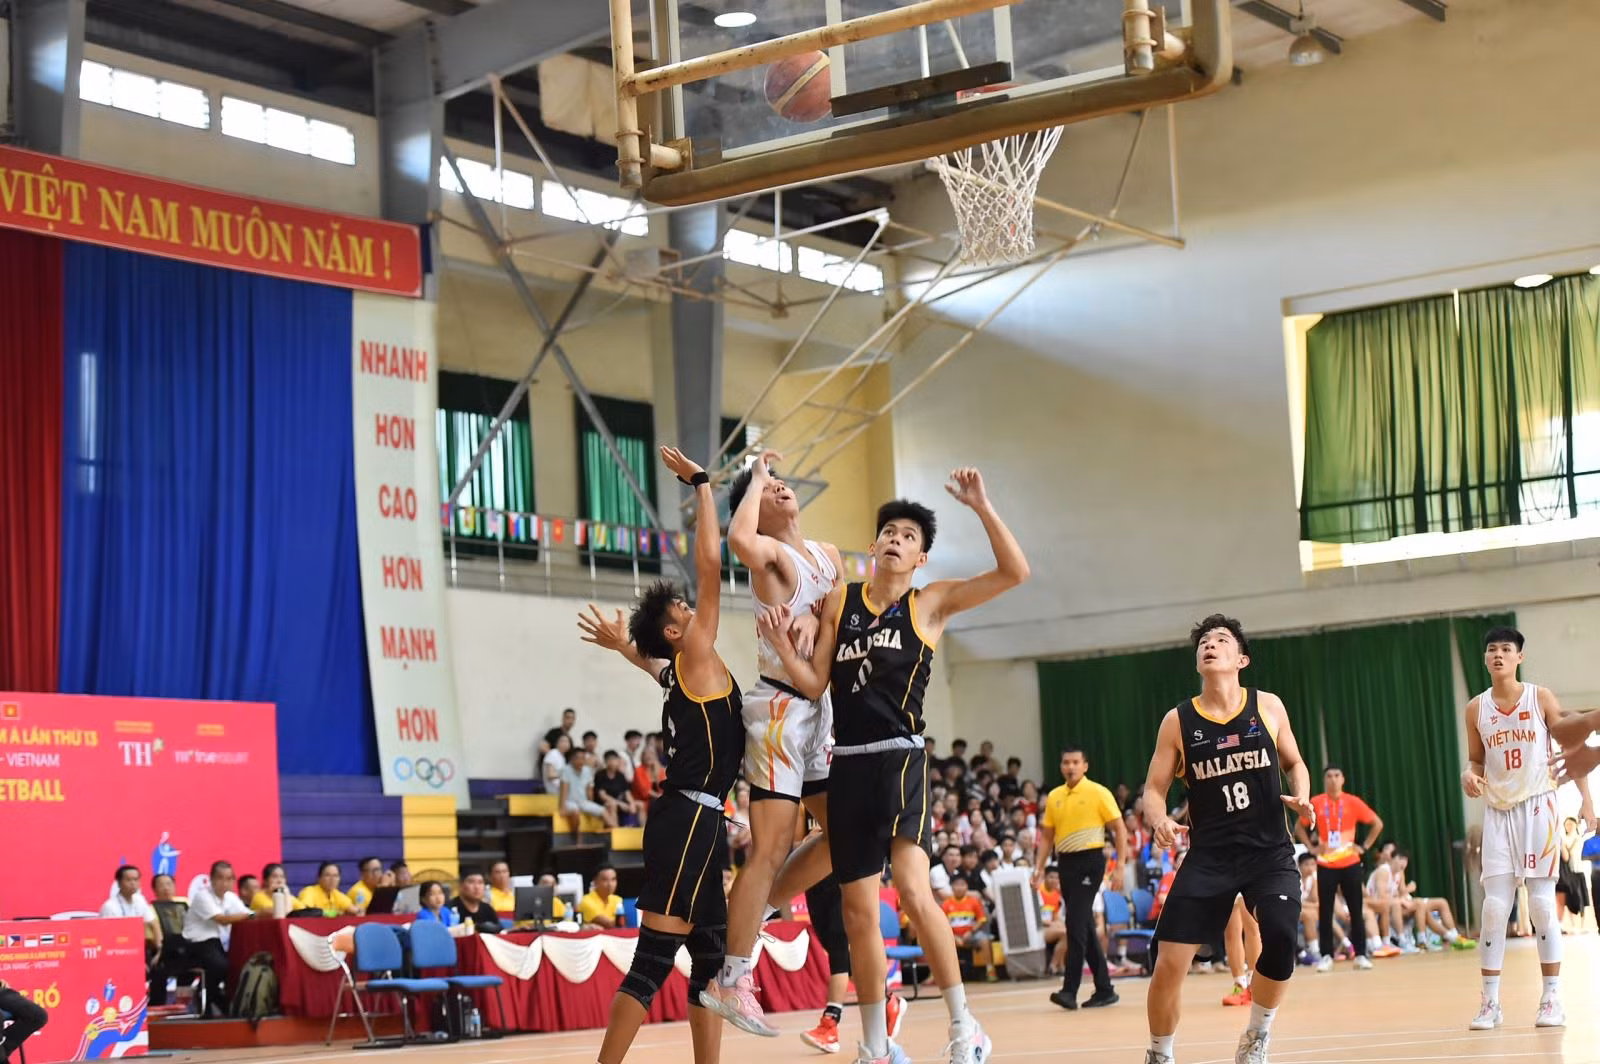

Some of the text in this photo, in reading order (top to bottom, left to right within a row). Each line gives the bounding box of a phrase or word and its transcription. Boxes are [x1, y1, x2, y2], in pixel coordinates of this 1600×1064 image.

[98, 186, 181, 246] NAM
[190, 206, 294, 265] MUÔN
[303, 222, 376, 278] NĂM
[360, 339, 428, 383] NHANH
[378, 484, 417, 521] CAO
[380, 626, 437, 670] MẠNH
[1512, 728, 1537, 744] NAM
[6, 752, 60, 767] VIETNAM
[118, 741, 154, 767] TH
[1191, 747, 1271, 780] MALAYSIA
[1503, 747, 1522, 771] 18
[1221, 781, 1250, 813] 18
[1523, 853, 1536, 869] 18
